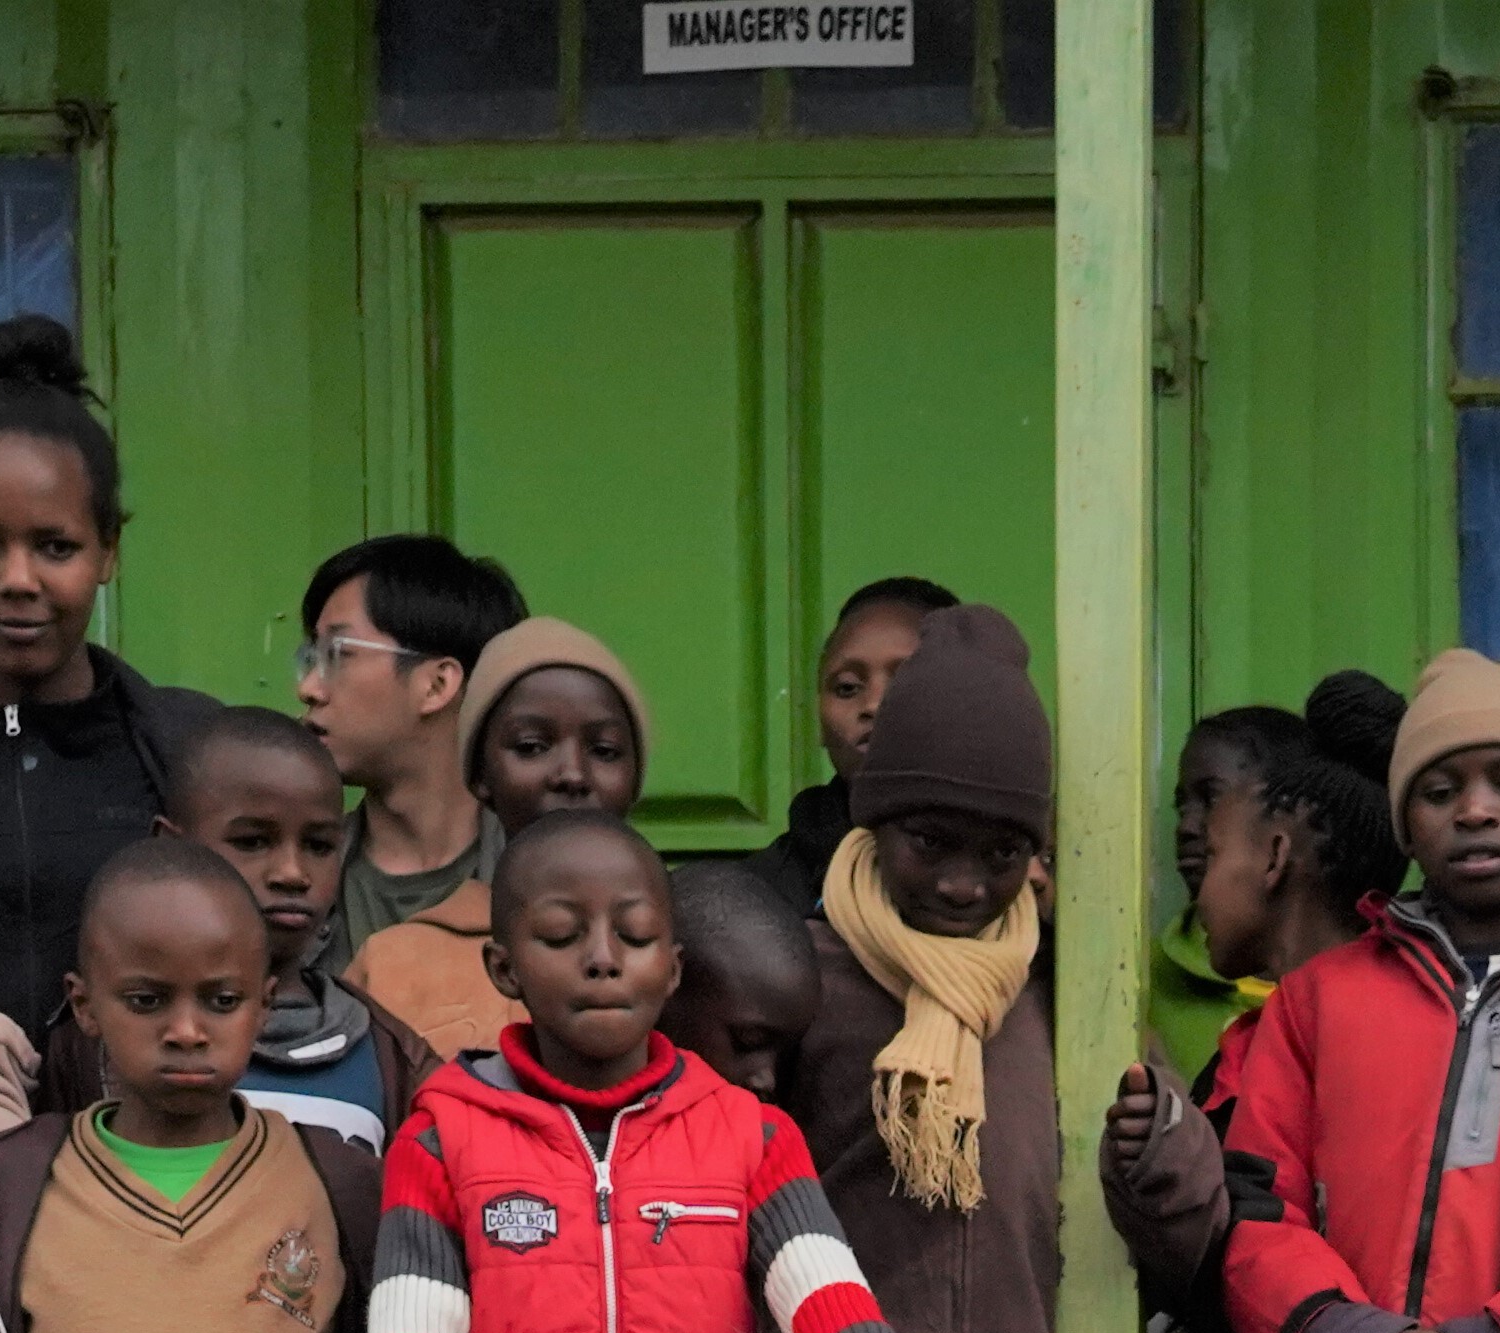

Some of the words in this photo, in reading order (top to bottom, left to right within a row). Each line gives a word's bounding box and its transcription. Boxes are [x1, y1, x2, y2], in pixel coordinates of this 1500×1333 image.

[668, 7, 809, 47] MANAGER'S
[818, 7, 905, 42] OFFICE
[488, 1213, 520, 1228] COOL
[526, 1213, 552, 1227] BOY
